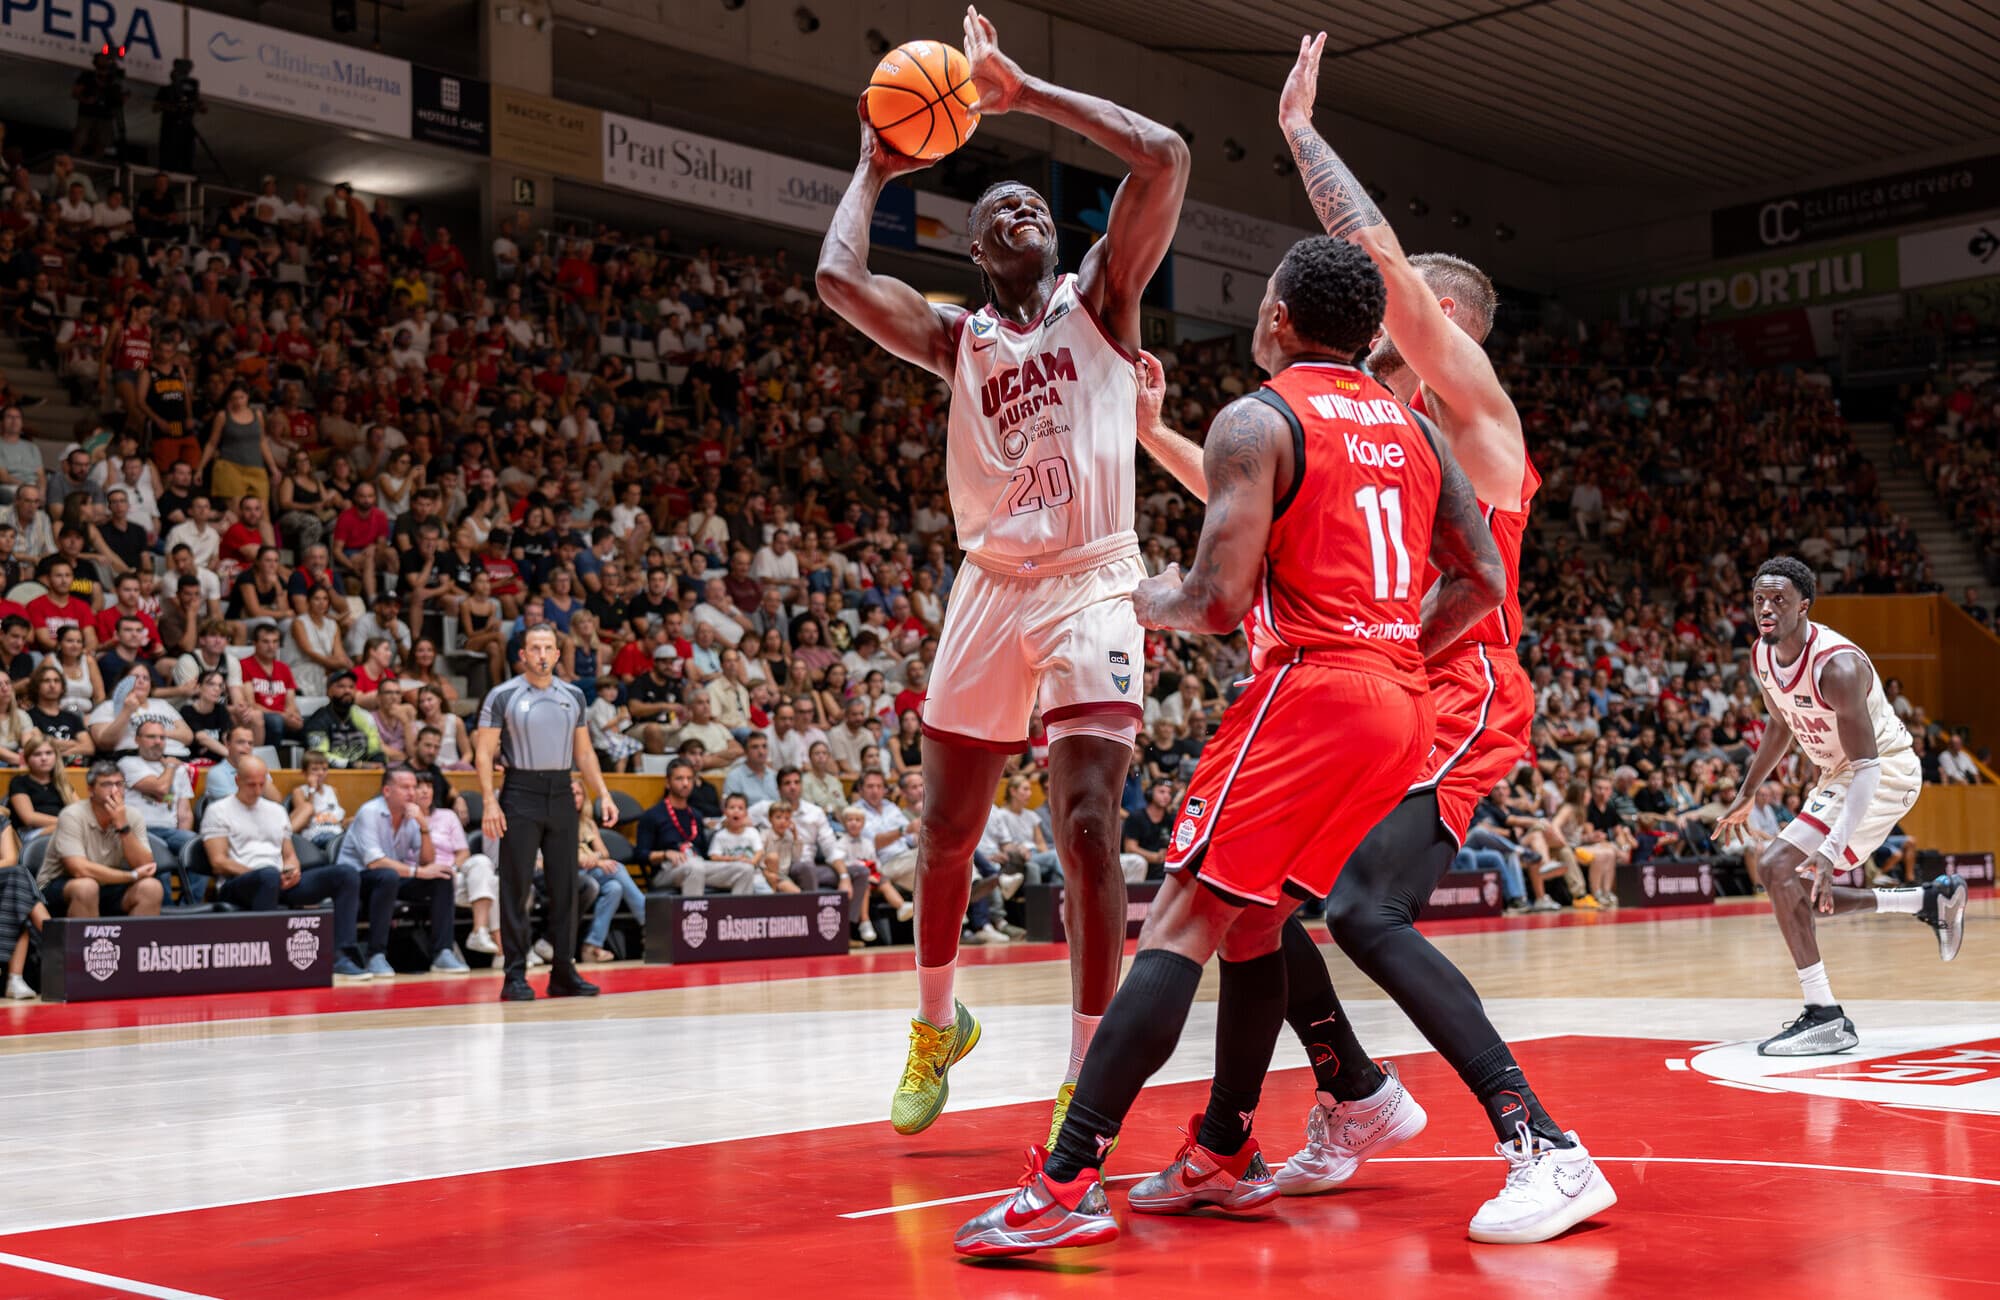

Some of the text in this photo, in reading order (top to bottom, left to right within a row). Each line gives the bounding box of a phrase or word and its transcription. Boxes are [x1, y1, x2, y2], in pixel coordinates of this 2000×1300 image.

[608, 123, 664, 169] Prat
[671, 140, 752, 191] Sàbat
[981, 347, 1078, 418] UCAM
[998, 387, 1063, 436] MURCIA
[1307, 393, 1409, 426] WHITTAKER
[1037, 424, 1071, 440] MURCIA
[1343, 432, 1406, 469] Kave
[1008, 455, 1073, 517] 20
[1353, 485, 1412, 603] 11
[1110, 655, 1126, 664] acb
[84, 925, 121, 938] FIATC
[287, 916, 321, 930] FIATC
[717, 914, 768, 942] BÀSQUET
[768, 915, 809, 938] GIRONA
[137, 940, 272, 974] BÀSQUET GIRONA
